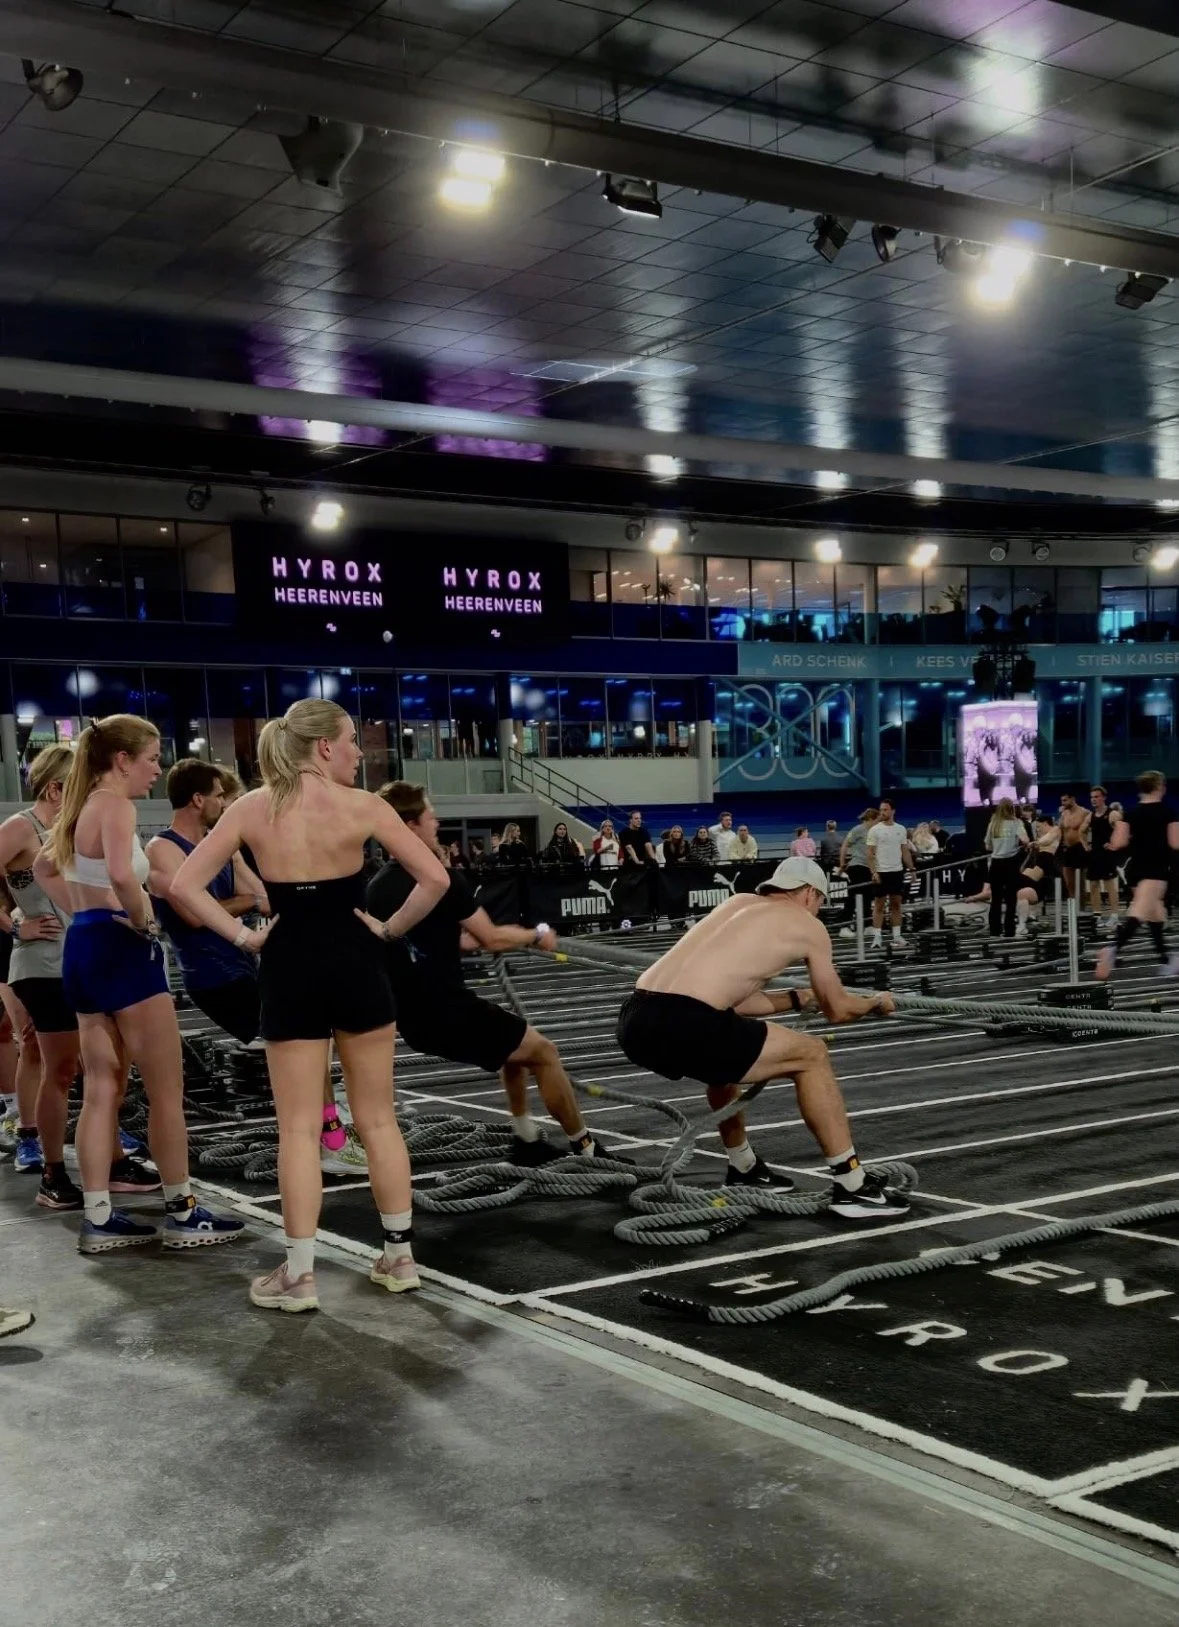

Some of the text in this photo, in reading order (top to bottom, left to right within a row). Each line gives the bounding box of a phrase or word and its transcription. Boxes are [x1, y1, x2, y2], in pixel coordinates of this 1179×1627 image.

[272, 556, 383, 583] HYROX
[443, 566, 542, 591] HYROX
[274, 586, 384, 608] HEERENVEEN
[444, 595, 543, 615] HEERENVEEN
[773, 653, 867, 668] ARD SCHENK
[916, 655, 955, 668] KEES
[1076, 653, 1121, 666] STIEN
[561, 895, 608, 917] PUMA
[688, 888, 730, 909] PUMA
